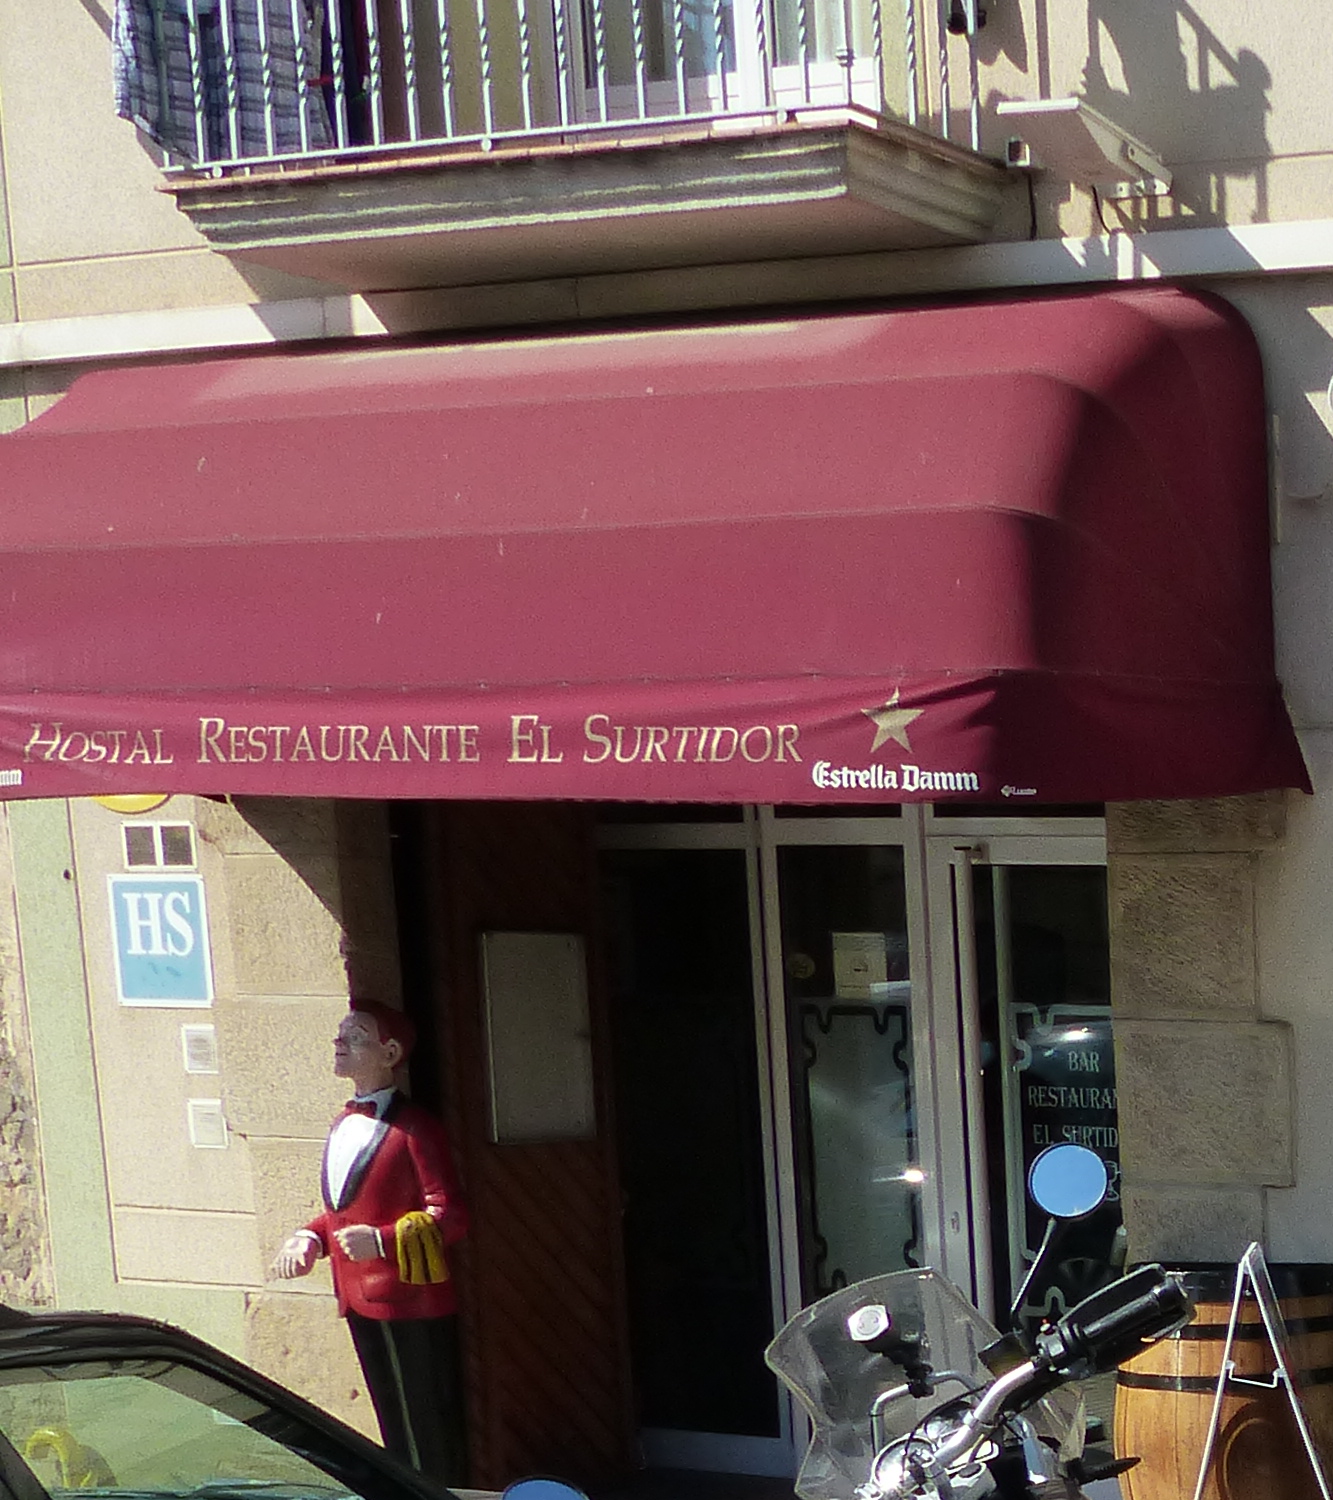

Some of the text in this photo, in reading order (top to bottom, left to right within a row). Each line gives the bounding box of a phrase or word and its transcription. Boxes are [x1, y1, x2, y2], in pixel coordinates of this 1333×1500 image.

[812, 760, 899, 790] Estrella
[900, 764, 979, 792] Damm
[121, 891, 194, 957] HS
[1068, 1051, 1100, 1073] BAR
